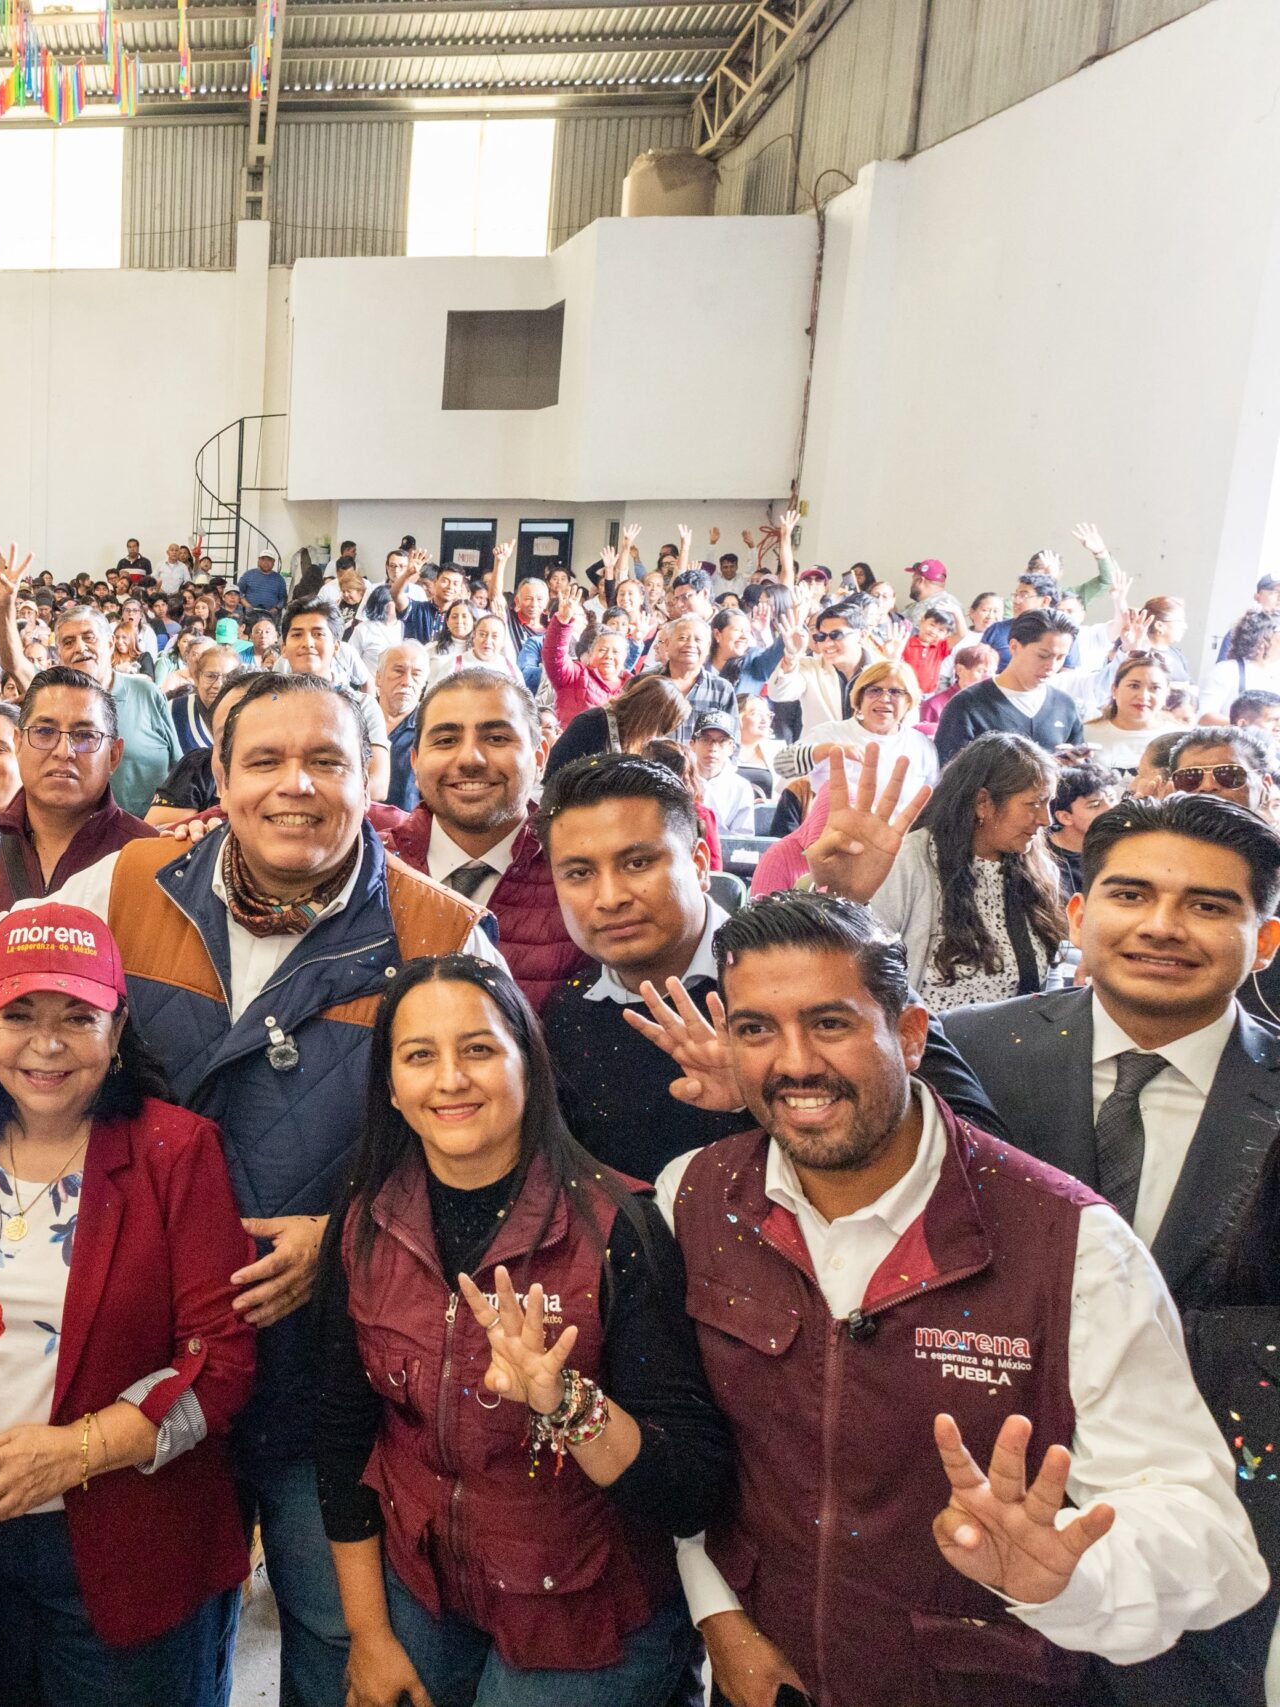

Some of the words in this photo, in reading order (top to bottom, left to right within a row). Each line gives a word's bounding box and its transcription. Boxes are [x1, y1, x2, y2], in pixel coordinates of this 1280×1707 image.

[8, 925, 96, 949] morena
[6, 945, 15, 954] La
[15, 943, 55, 952] esperanza
[59, 943, 69, 951] de
[72, 944, 98, 956] México
[482, 1292, 562, 1312] mra
[915, 1327, 1031, 1358] morena
[915, 1349, 927, 1359] La
[930, 1351, 978, 1365] esperanza
[982, 1357, 994, 1367] de
[998, 1358, 1032, 1371] México
[942, 1364, 1012, 1386] PUEBLA
